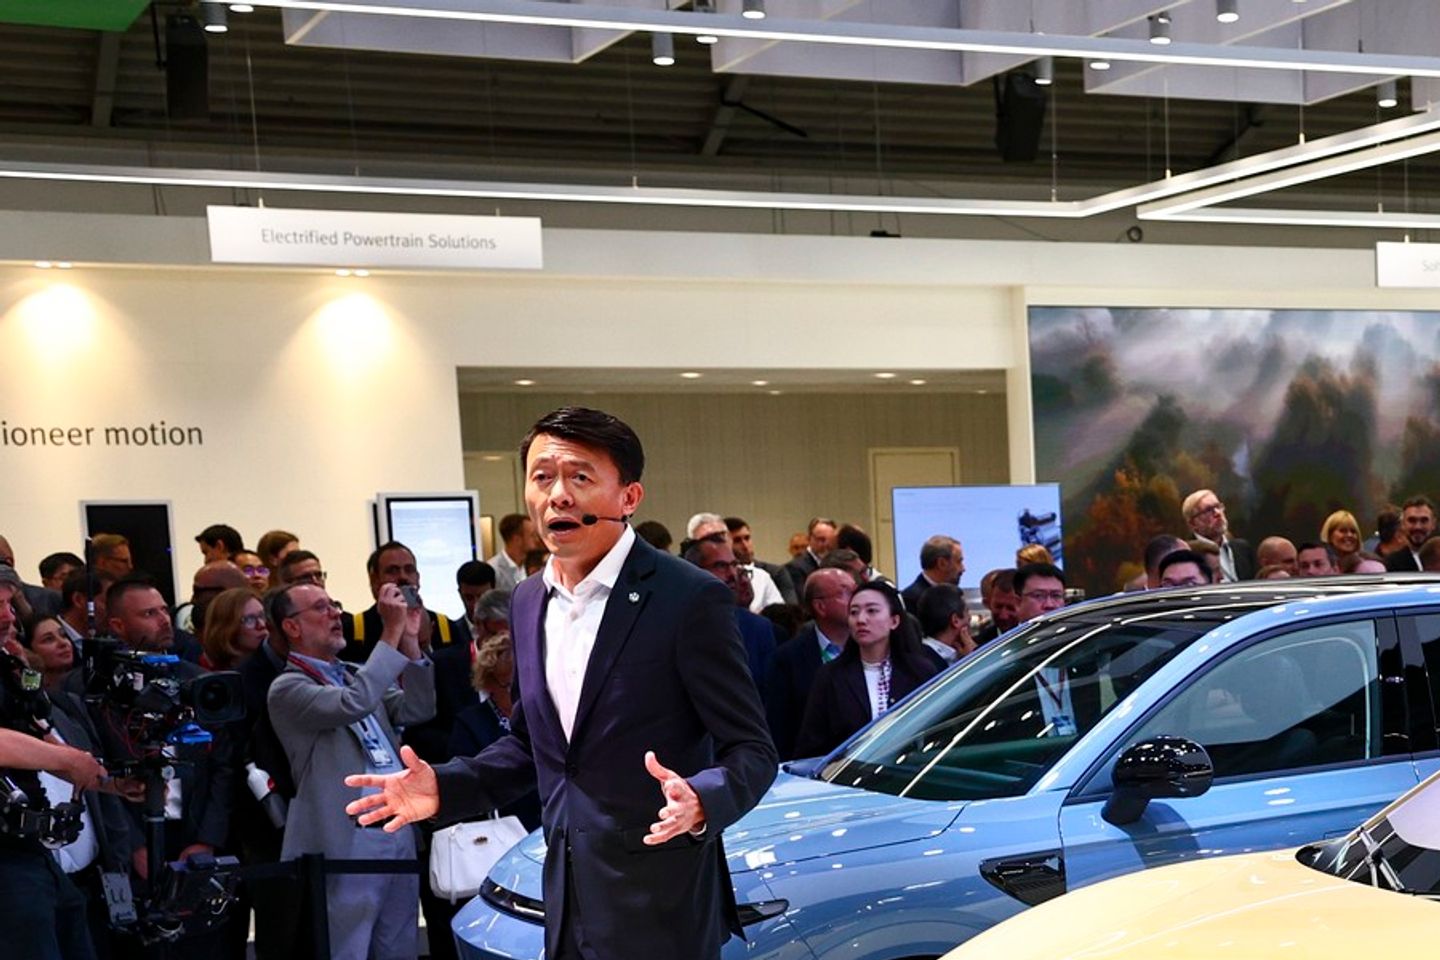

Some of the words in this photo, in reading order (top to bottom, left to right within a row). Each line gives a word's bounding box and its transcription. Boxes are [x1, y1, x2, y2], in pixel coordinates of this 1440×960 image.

[260, 227, 339, 247] Electrified
[343, 230, 424, 249] Powertrain
[428, 233, 497, 250] Solutions
[104, 420, 203, 447] motion
